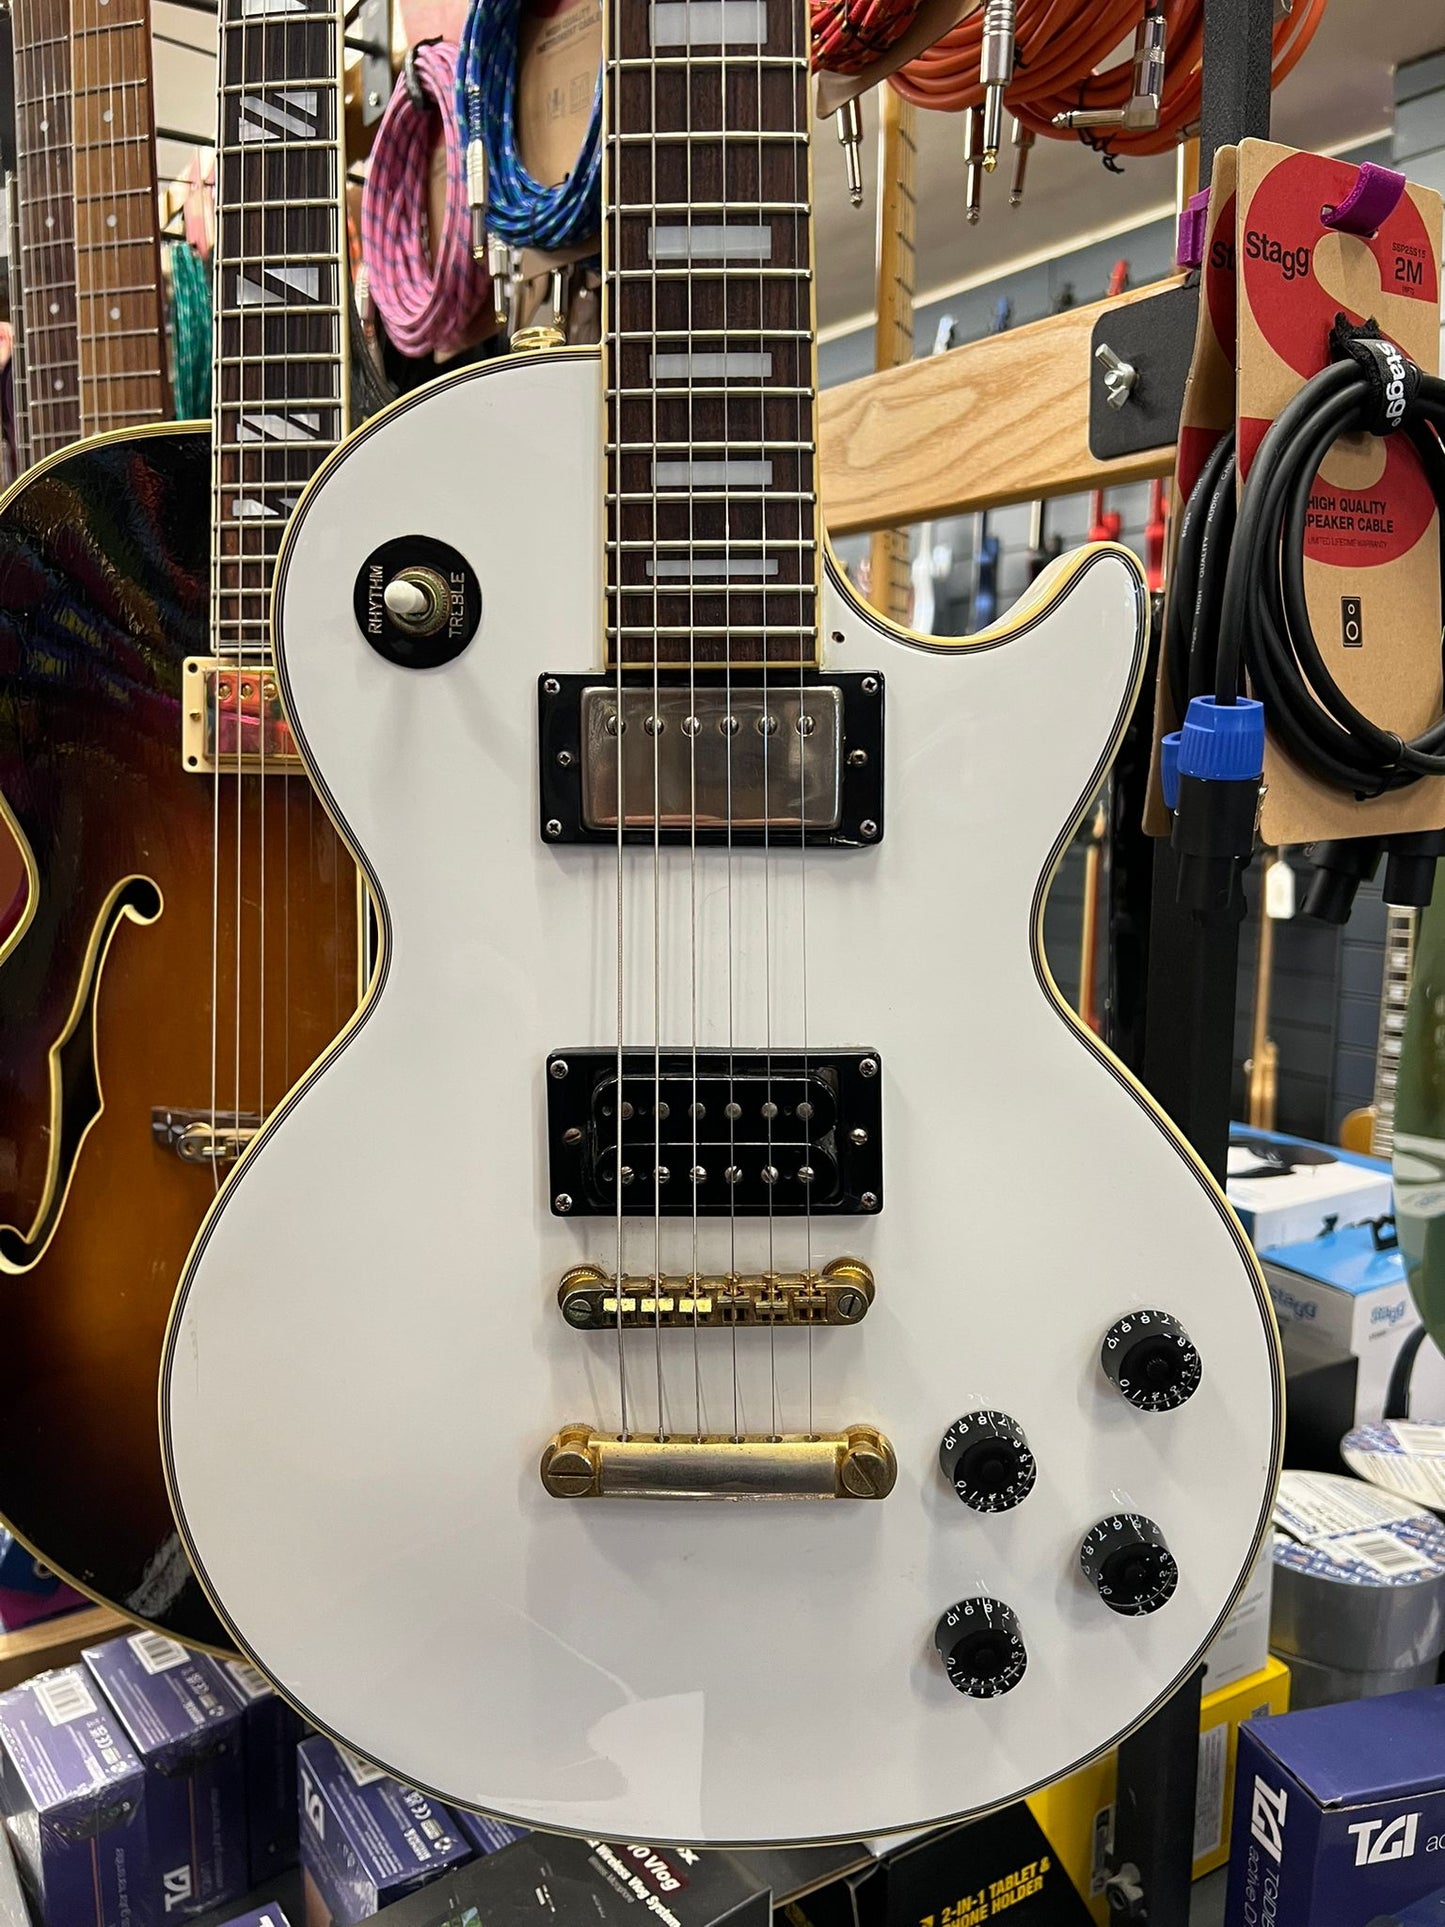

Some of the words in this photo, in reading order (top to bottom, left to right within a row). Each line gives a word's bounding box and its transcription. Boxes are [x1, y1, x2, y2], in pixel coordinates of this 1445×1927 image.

[1246, 231, 1311, 280] Stagg
[1395, 256, 1422, 285] 2M
[1306, 495, 1336, 510] HIGH
[1339, 498, 1386, 515] QUALITY
[1357, 517, 1394, 533] CABLE
[1199, 536, 1209, 578] QUALITY
[1207, 491, 1220, 522] AUDIO
[368, 565, 383, 634] RHYTHM
[448, 571, 465, 638] TREBLE
[1251, 1774, 1288, 1864] TGI
[1347, 1812, 1419, 1867] TGI
[596, 1843, 632, 1880] Wireless
[627, 1876, 651, 1900] Vlog
[645, 1895, 681, 1927] System
[643, 1854, 681, 1892] Vlog
[941, 1889, 985, 1924] 2-IN-1
[988, 1861, 1038, 1899] TABLET
[1039, 1856, 1050, 1873] &
[991, 1875, 1044, 1915] HOLDER
